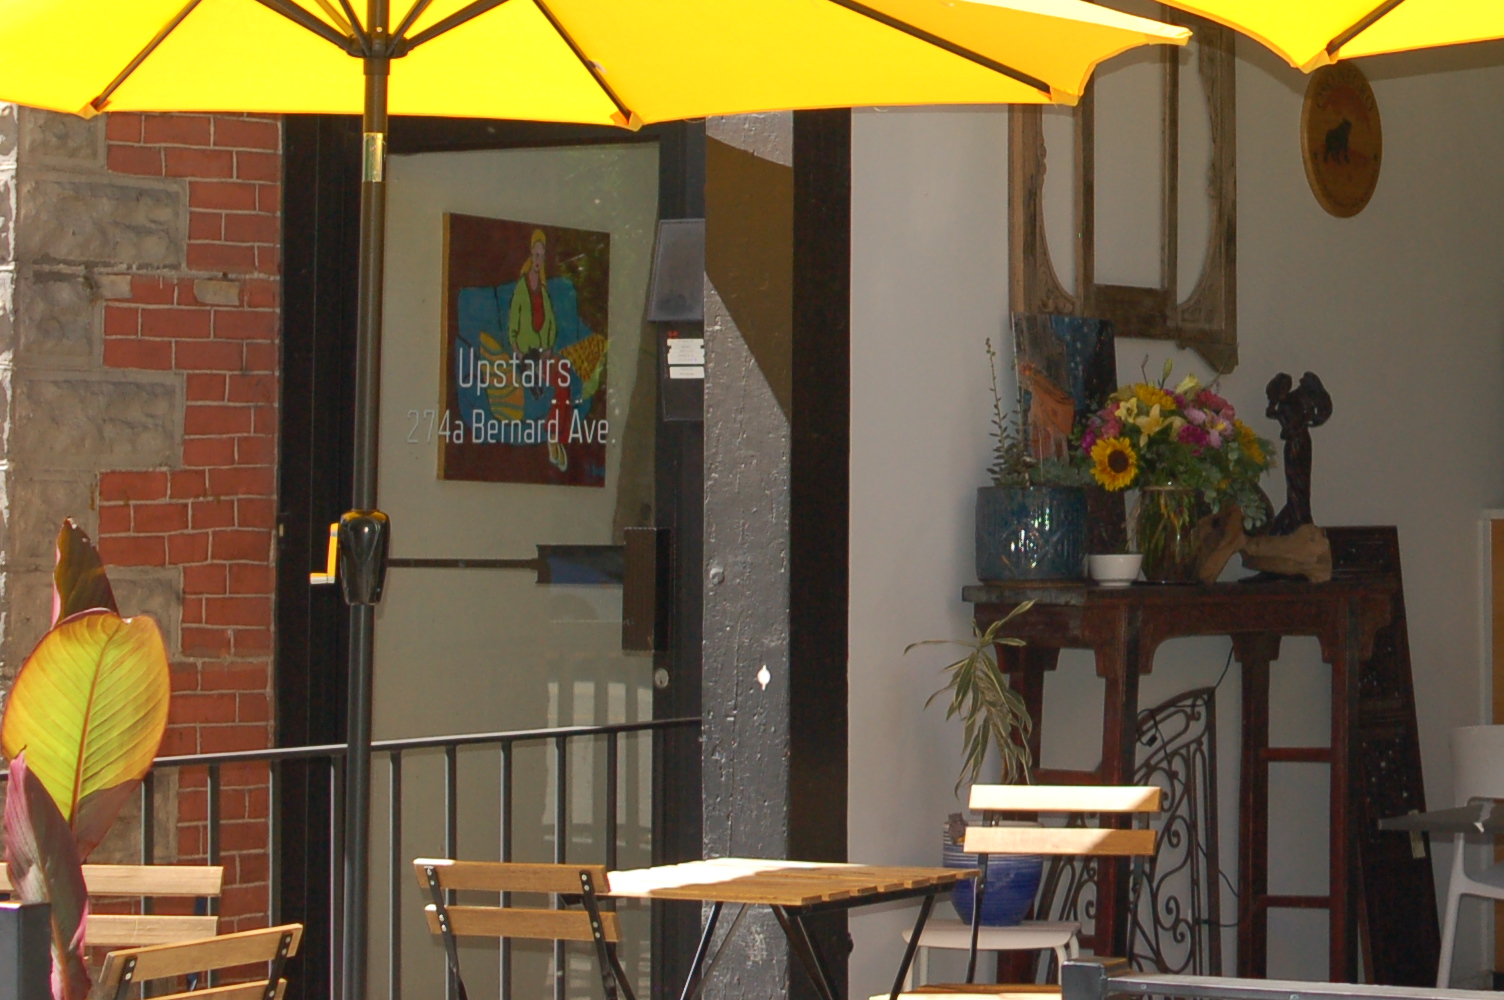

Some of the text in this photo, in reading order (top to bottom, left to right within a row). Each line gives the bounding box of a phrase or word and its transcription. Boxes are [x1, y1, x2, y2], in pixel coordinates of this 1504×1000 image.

[458, 348, 571, 395] Upstairs
[407, 409, 616, 444] 274a Bernard Ave.
